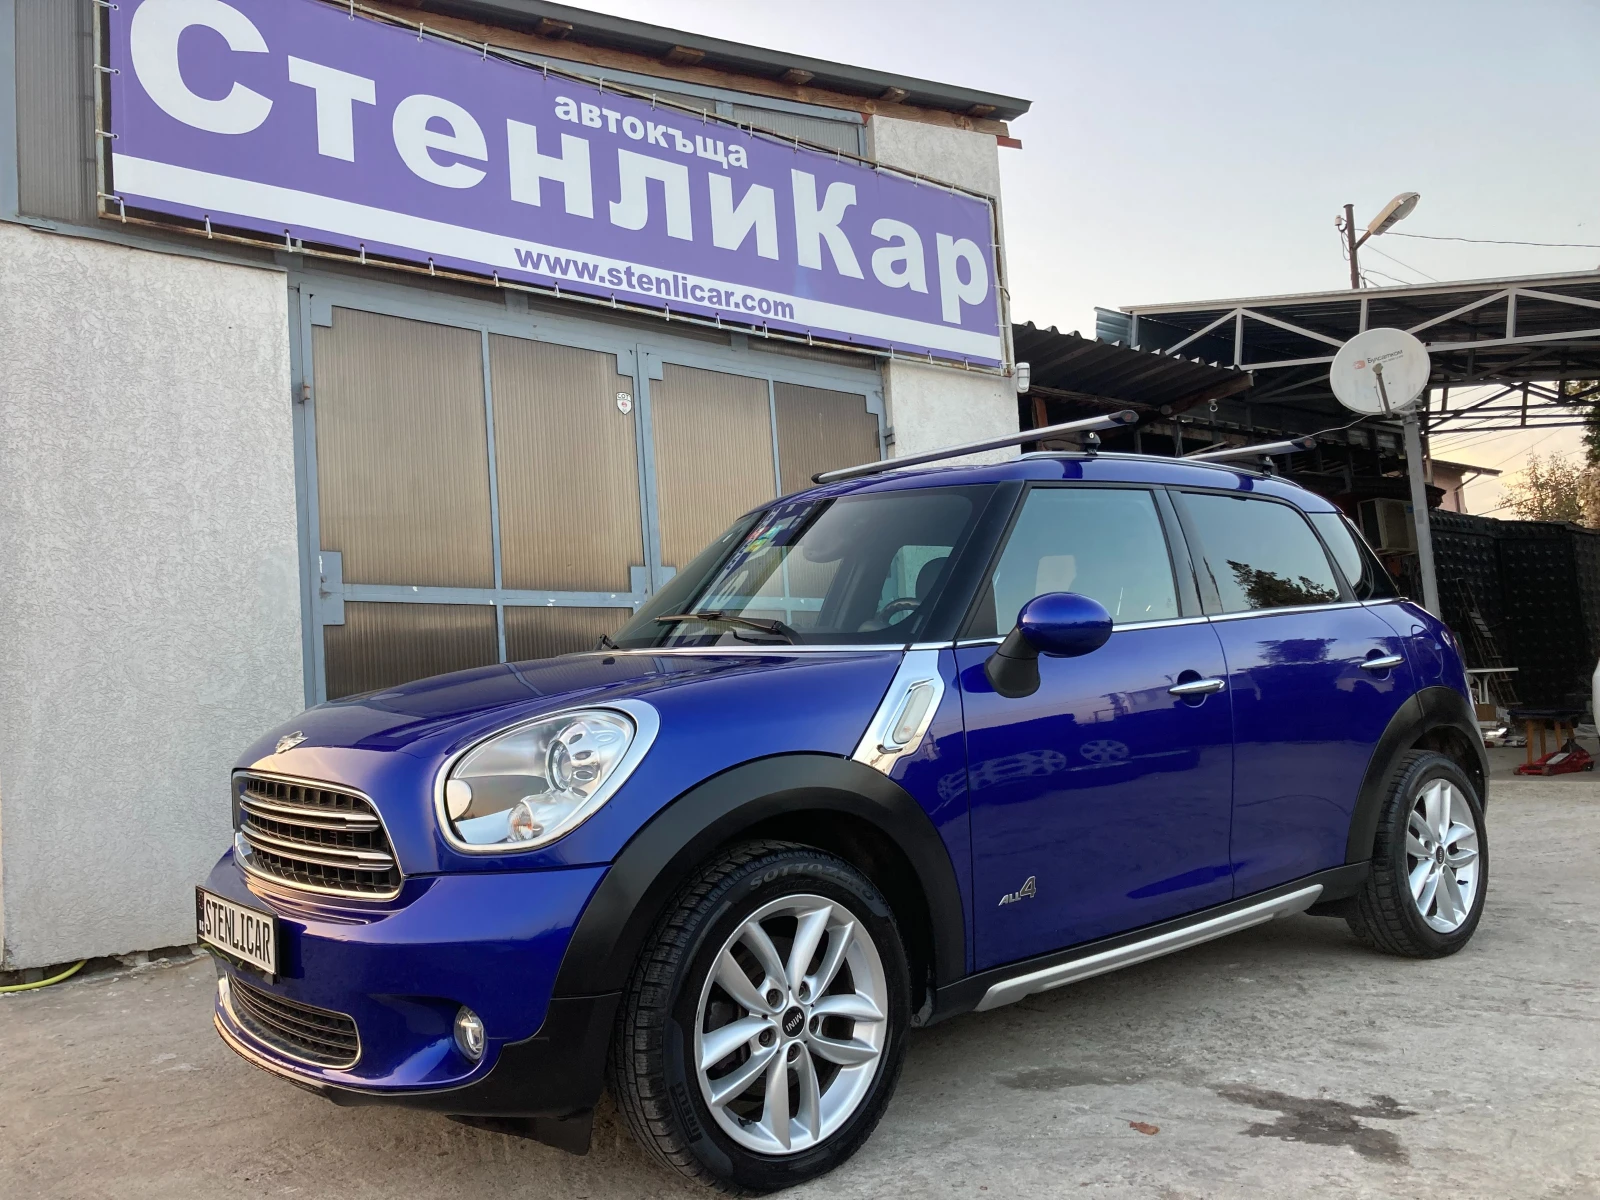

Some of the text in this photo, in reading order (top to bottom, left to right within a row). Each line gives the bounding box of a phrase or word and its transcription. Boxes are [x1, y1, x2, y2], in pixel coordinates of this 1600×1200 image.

[130, 0, 989, 324] СтенлиКар
[555, 96, 748, 169] автокъща
[514, 248, 795, 319] www.stenlicar.com
[750, 862, 876, 900] SOTTOZERO
[205, 899, 271, 965] STENLICAR
[785, 1011, 803, 1032] MINI
